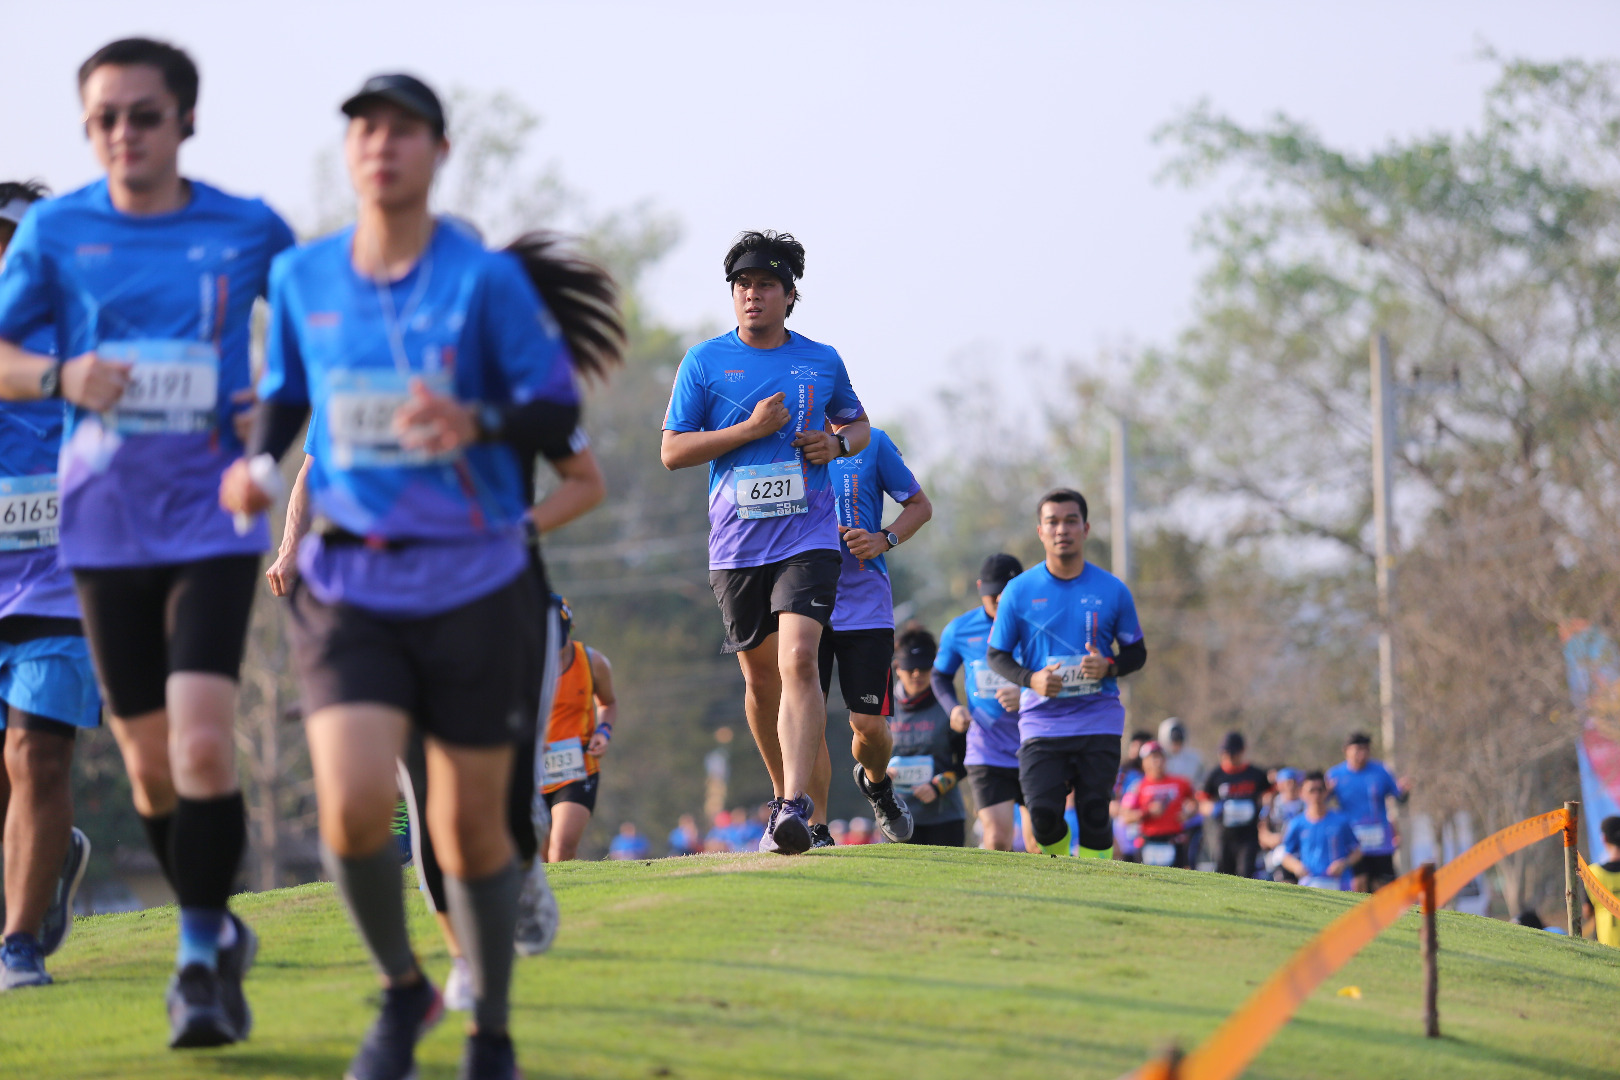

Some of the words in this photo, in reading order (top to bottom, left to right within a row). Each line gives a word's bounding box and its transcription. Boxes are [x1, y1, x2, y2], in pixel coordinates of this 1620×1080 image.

[805, 384, 815, 417] SINGHA
[750, 479, 791, 500] 6231
[851, 473, 859, 504] SINGHA
[4, 496, 58, 524] 6165
[852, 505, 860, 526] PARK
[1061, 669, 1085, 683] 614
